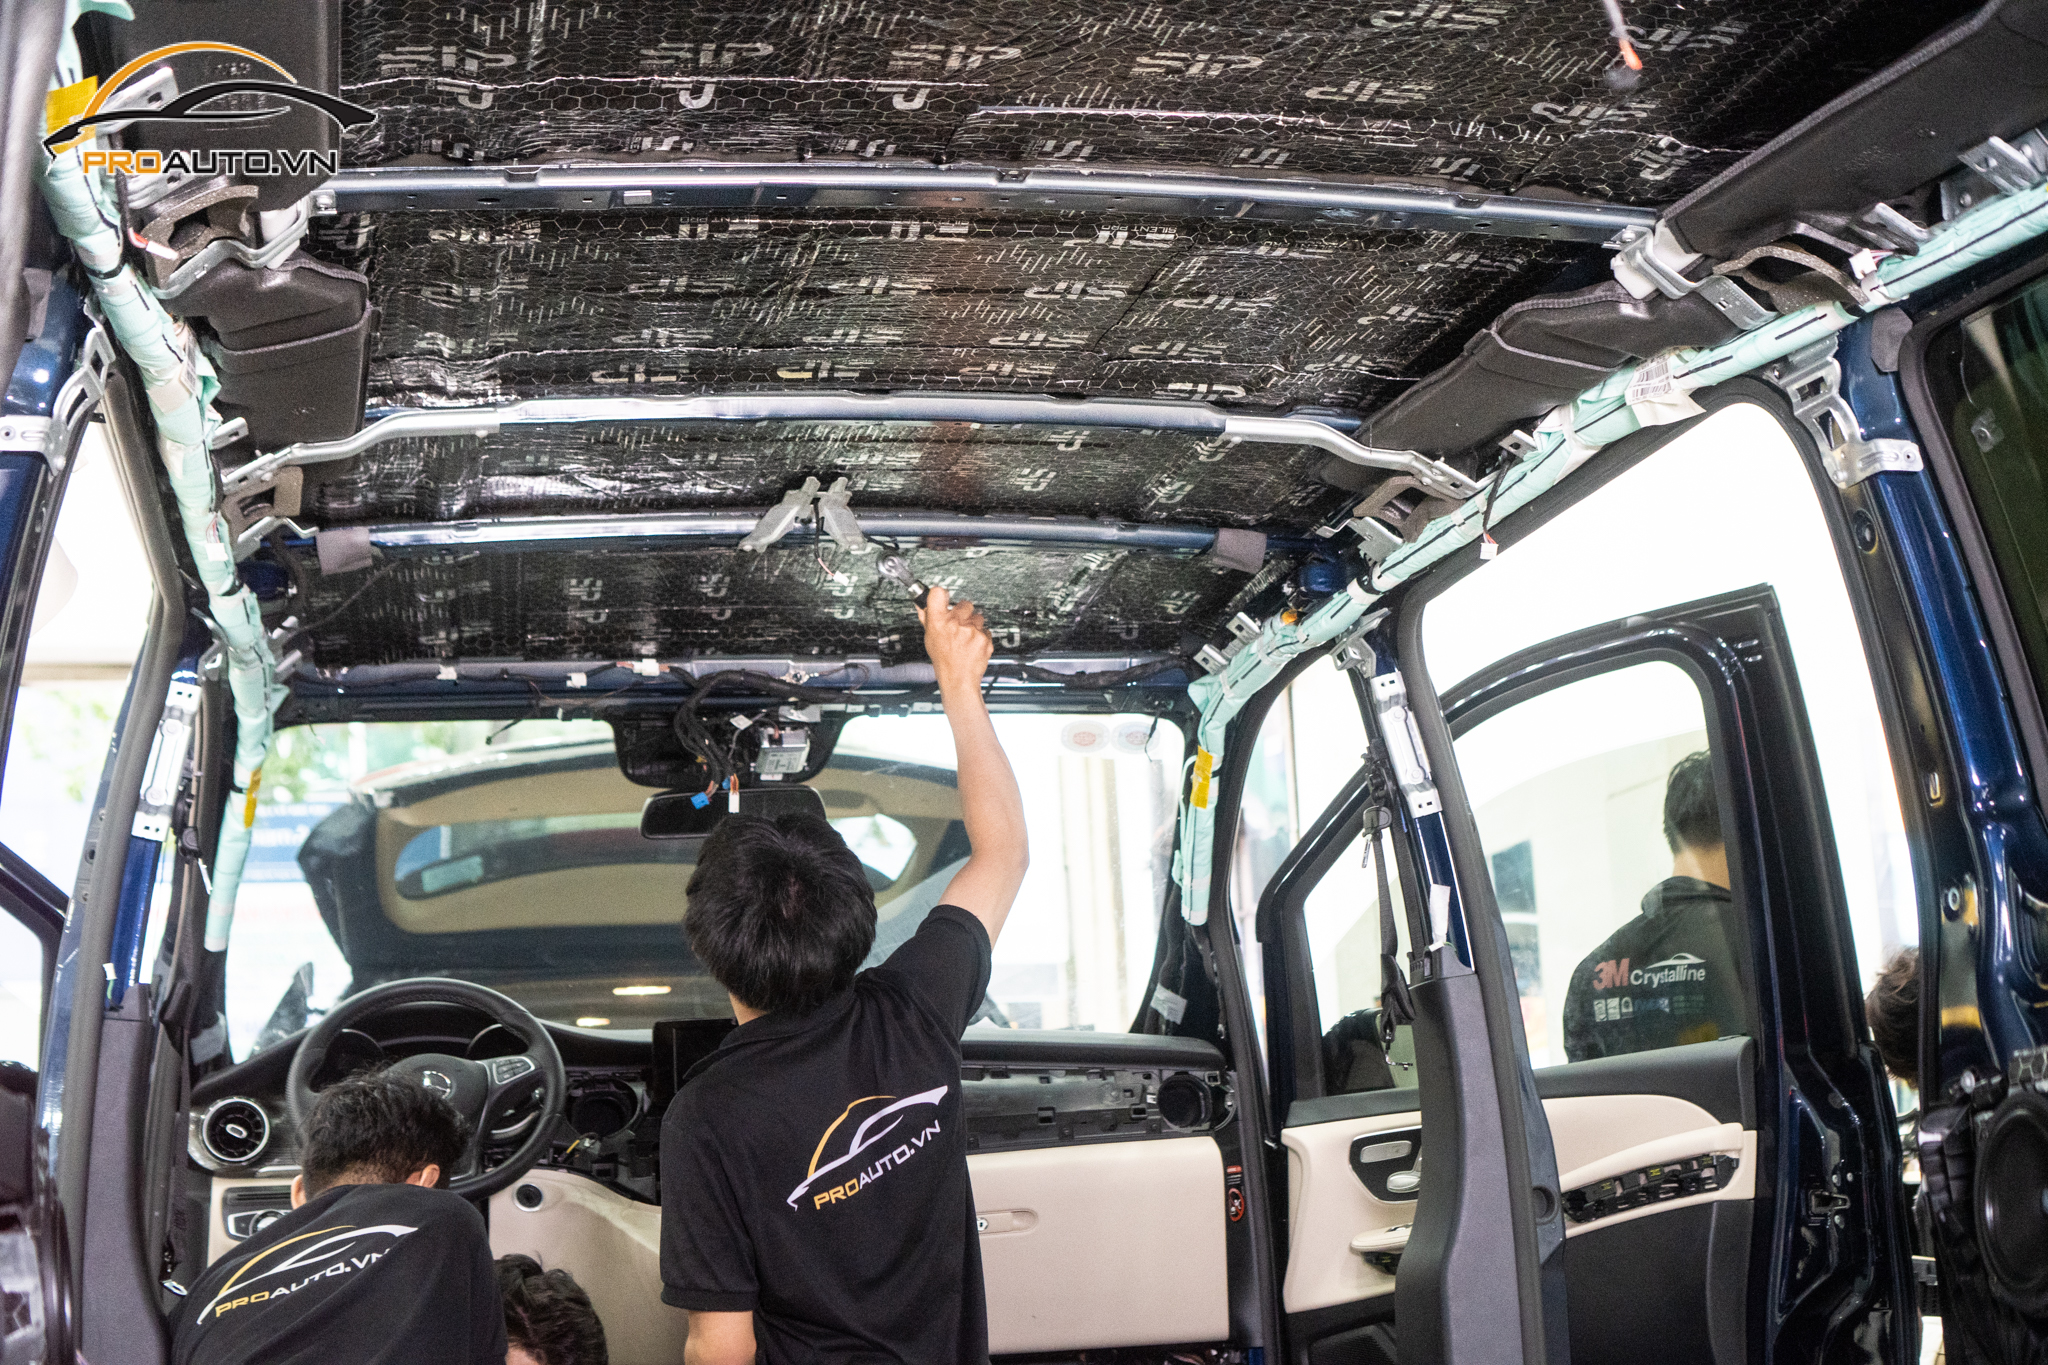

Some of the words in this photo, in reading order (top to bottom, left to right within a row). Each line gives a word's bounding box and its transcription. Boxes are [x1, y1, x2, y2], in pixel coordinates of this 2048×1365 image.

[1592, 957, 1631, 991] 3M
[1630, 964, 1706, 989] Crystalline
[813, 1119, 942, 1211] PROAUTO.VN
